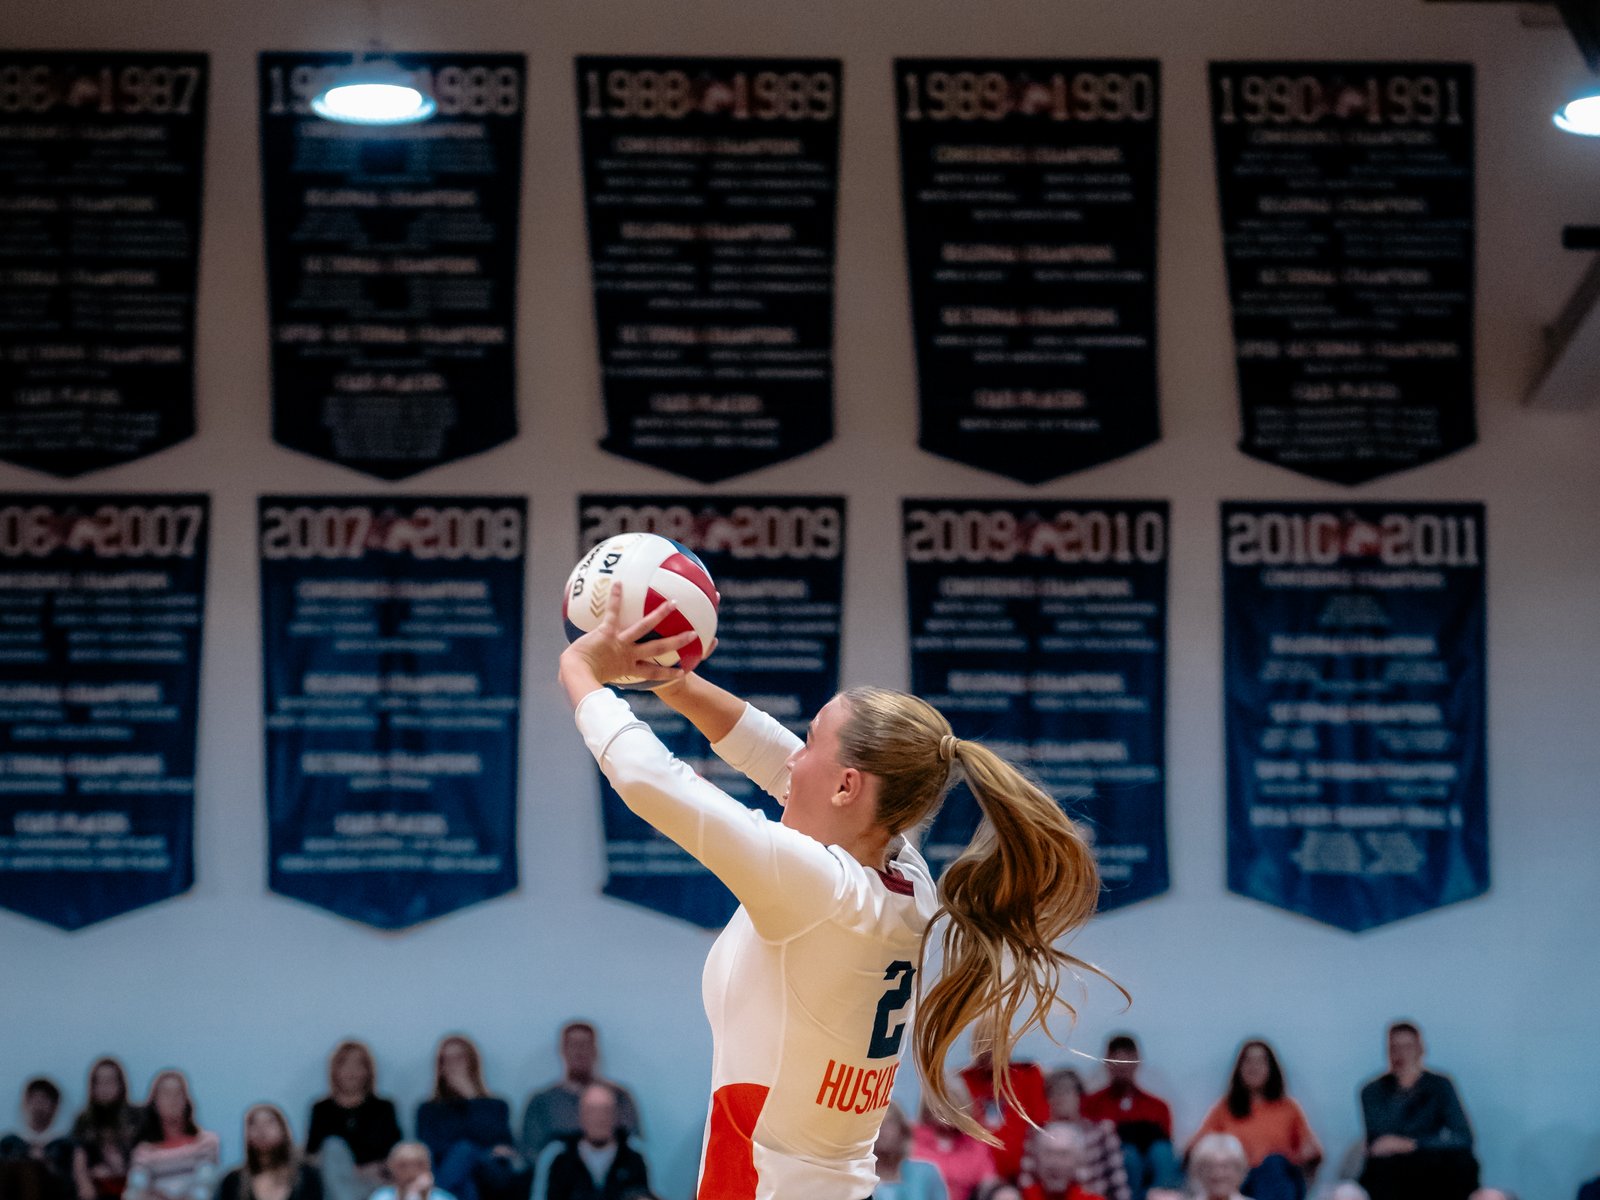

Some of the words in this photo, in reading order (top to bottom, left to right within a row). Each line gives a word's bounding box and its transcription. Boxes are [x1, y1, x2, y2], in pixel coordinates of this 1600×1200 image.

[0, 65, 58, 114] 86
[97, 65, 200, 114] 1987
[585, 69, 690, 119] 1988
[731, 71, 835, 121] 1989
[905, 72, 1009, 121] 1989
[1050, 73, 1153, 122] 1990
[1220, 76, 1321, 124] 1990
[1366, 77, 1461, 124] 1991
[0, 505, 55, 558] 06
[94, 505, 203, 559] 2007
[262, 506, 373, 560] 2007
[411, 506, 522, 561] 2008
[731, 505, 842, 560] 2009
[907, 508, 1020, 563] 2009
[1054, 509, 1166, 564] 2010
[1227, 511, 1341, 565] 2010
[1379, 513, 1480, 567] 2011
[867, 960, 917, 1059] 2
[815, 1059, 900, 1114] HUSKIE
